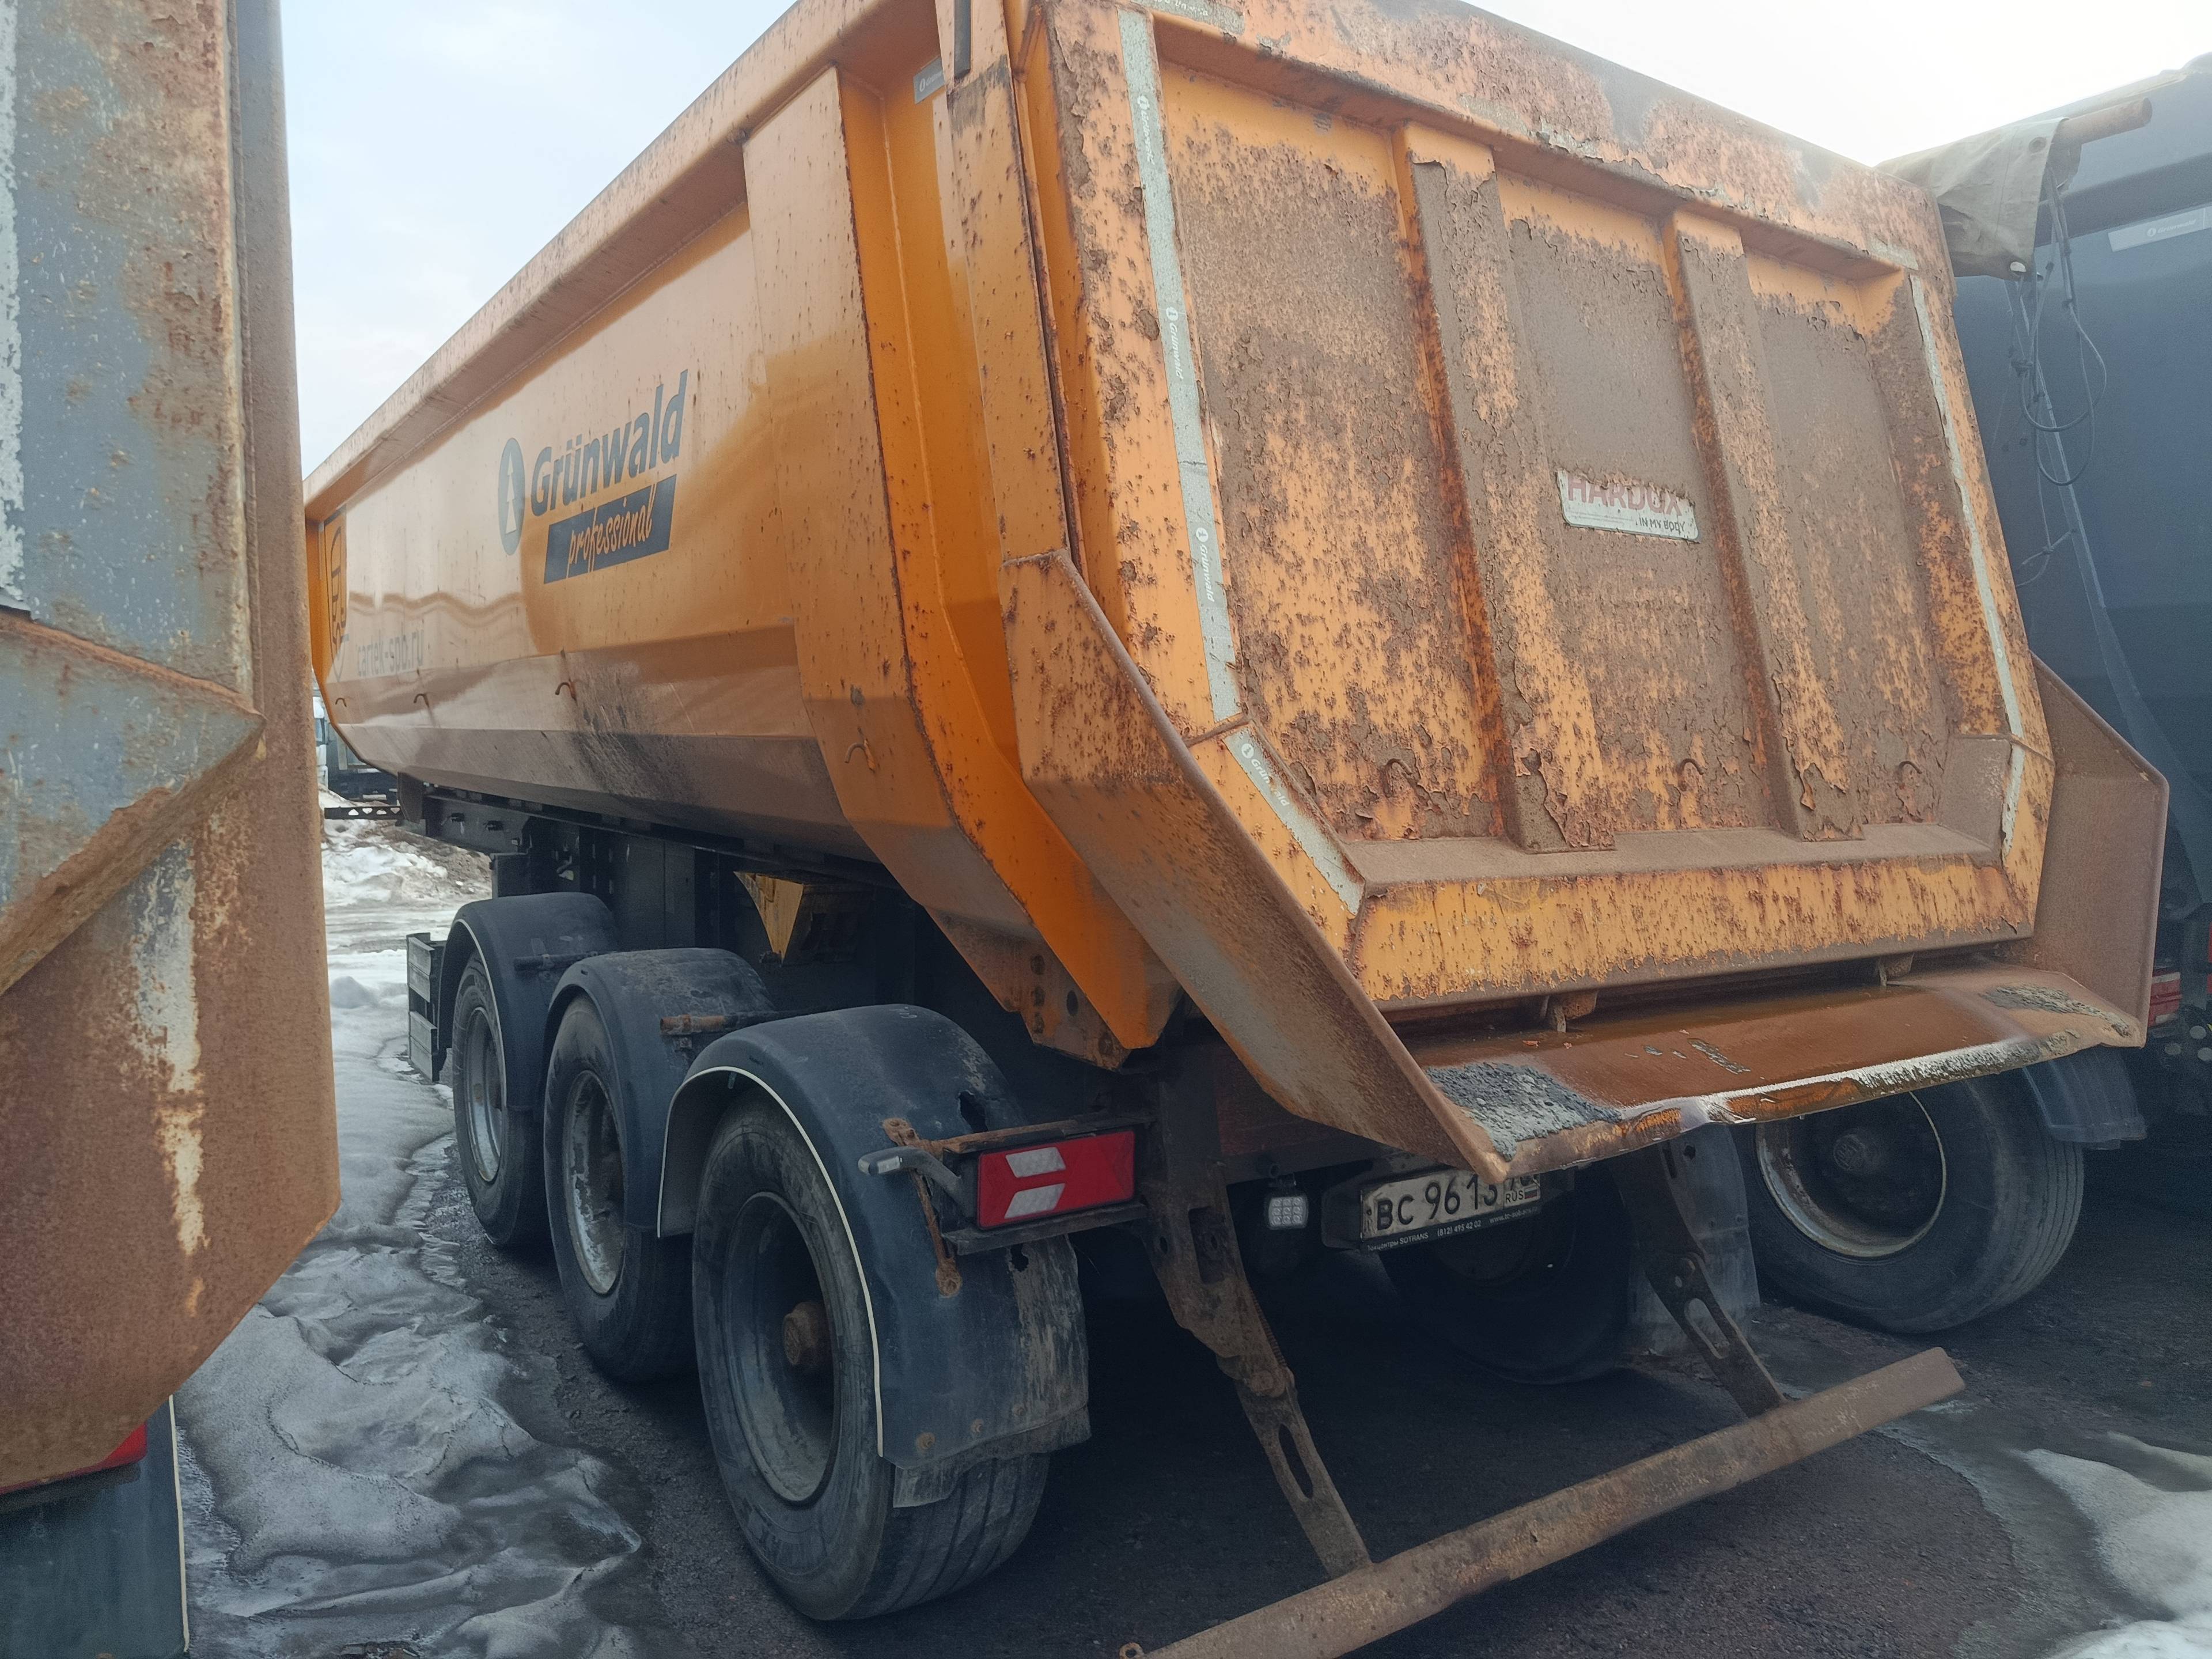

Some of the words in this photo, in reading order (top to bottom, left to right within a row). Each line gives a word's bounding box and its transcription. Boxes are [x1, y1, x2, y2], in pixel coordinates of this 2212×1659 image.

[531, 369, 688, 517] Grünwald
[1567, 474, 1683, 516] HARDOX
[566, 483, 657, 578] professional
[1639, 517, 1648, 527] IN
[1650, 518, 1662, 529] MY
[1664, 521, 1685, 533] BODY
[1505, 1190, 1524, 1203] RUS
[1399, 1232, 1429, 1245] SOTRANS
[1437, 1225, 1453, 1237] (812)
